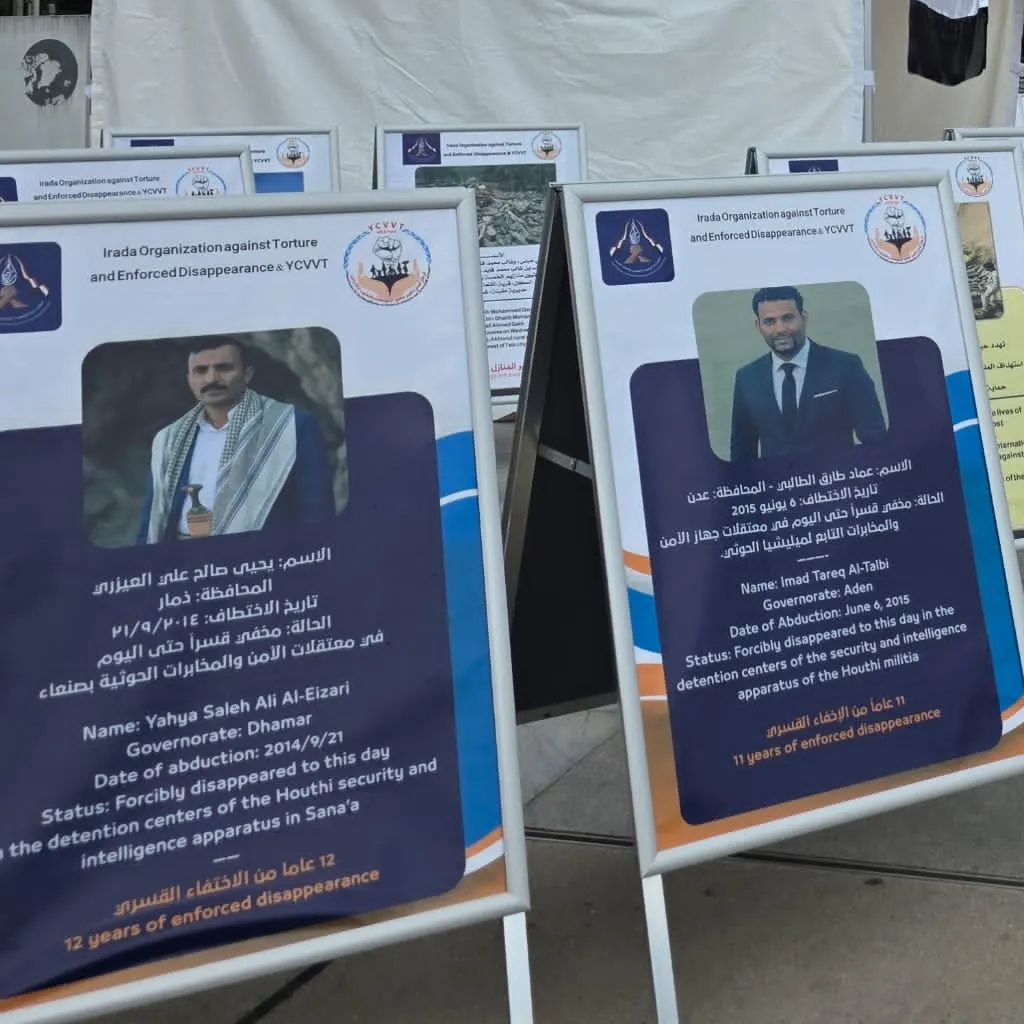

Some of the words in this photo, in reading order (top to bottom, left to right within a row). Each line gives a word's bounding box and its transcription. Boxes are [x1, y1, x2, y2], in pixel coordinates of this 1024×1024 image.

[40, 179, 58, 187] Irada
[59, 177, 105, 188] Organization
[106, 176, 134, 186] against
[697, 213, 721, 223] Irada
[722, 209, 780, 224] Organization
[780, 208, 814, 222] against
[814, 206, 845, 216] Torture
[690, 232, 708, 242] and
[708, 230, 750, 241] Enforced
[751, 226, 817, 240] Disappearance
[824, 224, 854, 234] YCVVT
[103, 247, 137, 259] Irada
[139, 242, 223, 259] Organization
[224, 240, 271, 255] against
[272, 238, 318, 249] Torture
[90, 270, 115, 282] and
[117, 266, 177, 280] Enforced
[178, 262, 274, 279] Disappearance
[286, 258, 328, 270] YCVVT
[849, 466, 874, 480] عماد
[876, 459, 912, 476] الاسم:
[777, 474, 815, 492] الطالبي
[819, 470, 846, 486] طارق
[687, 491, 710, 504] عدن
[714, 480, 766, 499] المحافظة:
[800, 488, 852, 507] الاختطاف:
[853, 483, 878, 498] تاريخ
[914, 492, 944, 507] الحالة:
[731, 504, 756, 516] 2015
[760, 499, 786, 514] يونيو
[824, 508, 848, 523] حتى
[882, 498, 912, 514] مخفي
[722, 522, 768, 537] معتقلات
[771, 518, 788, 532] في
[792, 511, 821, 529] اليوم
[847, 519, 899, 537] والمخابرات
[694, 528, 720, 545] جهاز
[763, 532, 813, 552] لميليشيا
[816, 527, 844, 545] التابع
[233, 558, 274, 575] يحيى
[279, 547, 331, 570] الاسم:
[158, 569, 188, 586] علي
[193, 564, 228, 583] صالح
[740, 580, 778, 595] Name:
[781, 573, 810, 588] Imad
[812, 568, 846, 582] Tareq
[849, 558, 890, 576] Al-Talbi
[92, 572, 152, 596] العيزري
[196, 578, 272, 602] المحافظة:
[158, 590, 191, 612] ذمار
[284, 594, 319, 616] تاريخ
[763, 588, 841, 611] Governorate:
[844, 582, 873, 596] Aden
[204, 600, 280, 625] الاختطاف:
[730, 622, 759, 638] Date
[762, 618, 775, 631] of
[778, 608, 842, 629] Abduction:
[844, 602, 871, 616] June
[874, 600, 883, 612] 6,
[886, 594, 910, 608] 2015
[235, 625, 281, 644] مخفي
[286, 615, 331, 636] الحالة:
[360, 629, 384, 647] في
[686, 650, 732, 668] Status:
[734, 639, 782, 658] Forcibly
[784, 624, 856, 648] disappeared
[859, 620, 872, 633] to
[874, 615, 896, 630] this
[899, 612, 920, 626] day
[922, 608, 933, 621] in
[934, 604, 955, 617] the
[97, 644, 142, 668] اليوم
[148, 640, 184, 658] حتى
[291, 636, 355, 657] معتقلات
[164, 654, 242, 678] والمخابرات
[677, 670, 738, 692] detention
[742, 660, 788, 677] centers
[790, 654, 804, 667] of
[807, 650, 828, 664] the
[830, 641, 877, 660] security
[880, 634, 900, 650] and
[903, 622, 968, 644] intelligence
[100, 666, 158, 690] الحوثية
[738, 678, 800, 702] apparatus
[802, 672, 816, 686] of
[818, 668, 839, 683] the
[841, 659, 881, 678] Houthi
[884, 650, 920, 669] militia
[40, 679, 94, 700] بصنعاء
[82, 720, 140, 742] Name:
[146, 710, 198, 730] Yahya
[203, 700, 250, 720] Saleh
[255, 693, 277, 711] Ali
[282, 680, 350, 706] Al-Eizari
[126, 726, 242, 758] Governorate:
[247, 713, 312, 736] Dhamar
[733, 755, 744, 767] 11
[746, 746, 782, 766] years
[784, 740, 798, 754] of
[801, 728, 854, 750] enforced
[857, 708, 942, 737] disappearance
[94, 769, 138, 789] Date
[143, 763, 164, 780] of
[168, 747, 260, 776] abduction:
[264, 730, 344, 758] 2014/9/21
[41, 802, 110, 825] Status:
[115, 785, 186, 811] Forcibly
[190, 762, 296, 795] disappeared
[302, 757, 320, 773] to
[324, 752, 357, 769] this
[360, 746, 390, 762] day
[9, 840, 42, 858] the
[48, 821, 140, 850] detention
[144, 804, 212, 830] centers
[217, 799, 236, 815] of
[242, 792, 271, 810] the
[276, 780, 334, 803] Houthi
[338, 768, 404, 792] security
[408, 758, 438, 776] and
[81, 836, 187, 870] intelligence
[192, 816, 280, 846] apparatus
[286, 812, 300, 826] in
[320, 853, 336, 868] 12
[186, 870, 249, 899] الاختفاء
[253, 868, 277, 884] من
[64, 935, 84, 953] 12
[88, 922, 142, 950] years
[146, 916, 166, 933] of
[171, 895, 252, 927] enforced
[256, 868, 380, 908] disappearance
[112, 884, 181, 917] القسري
